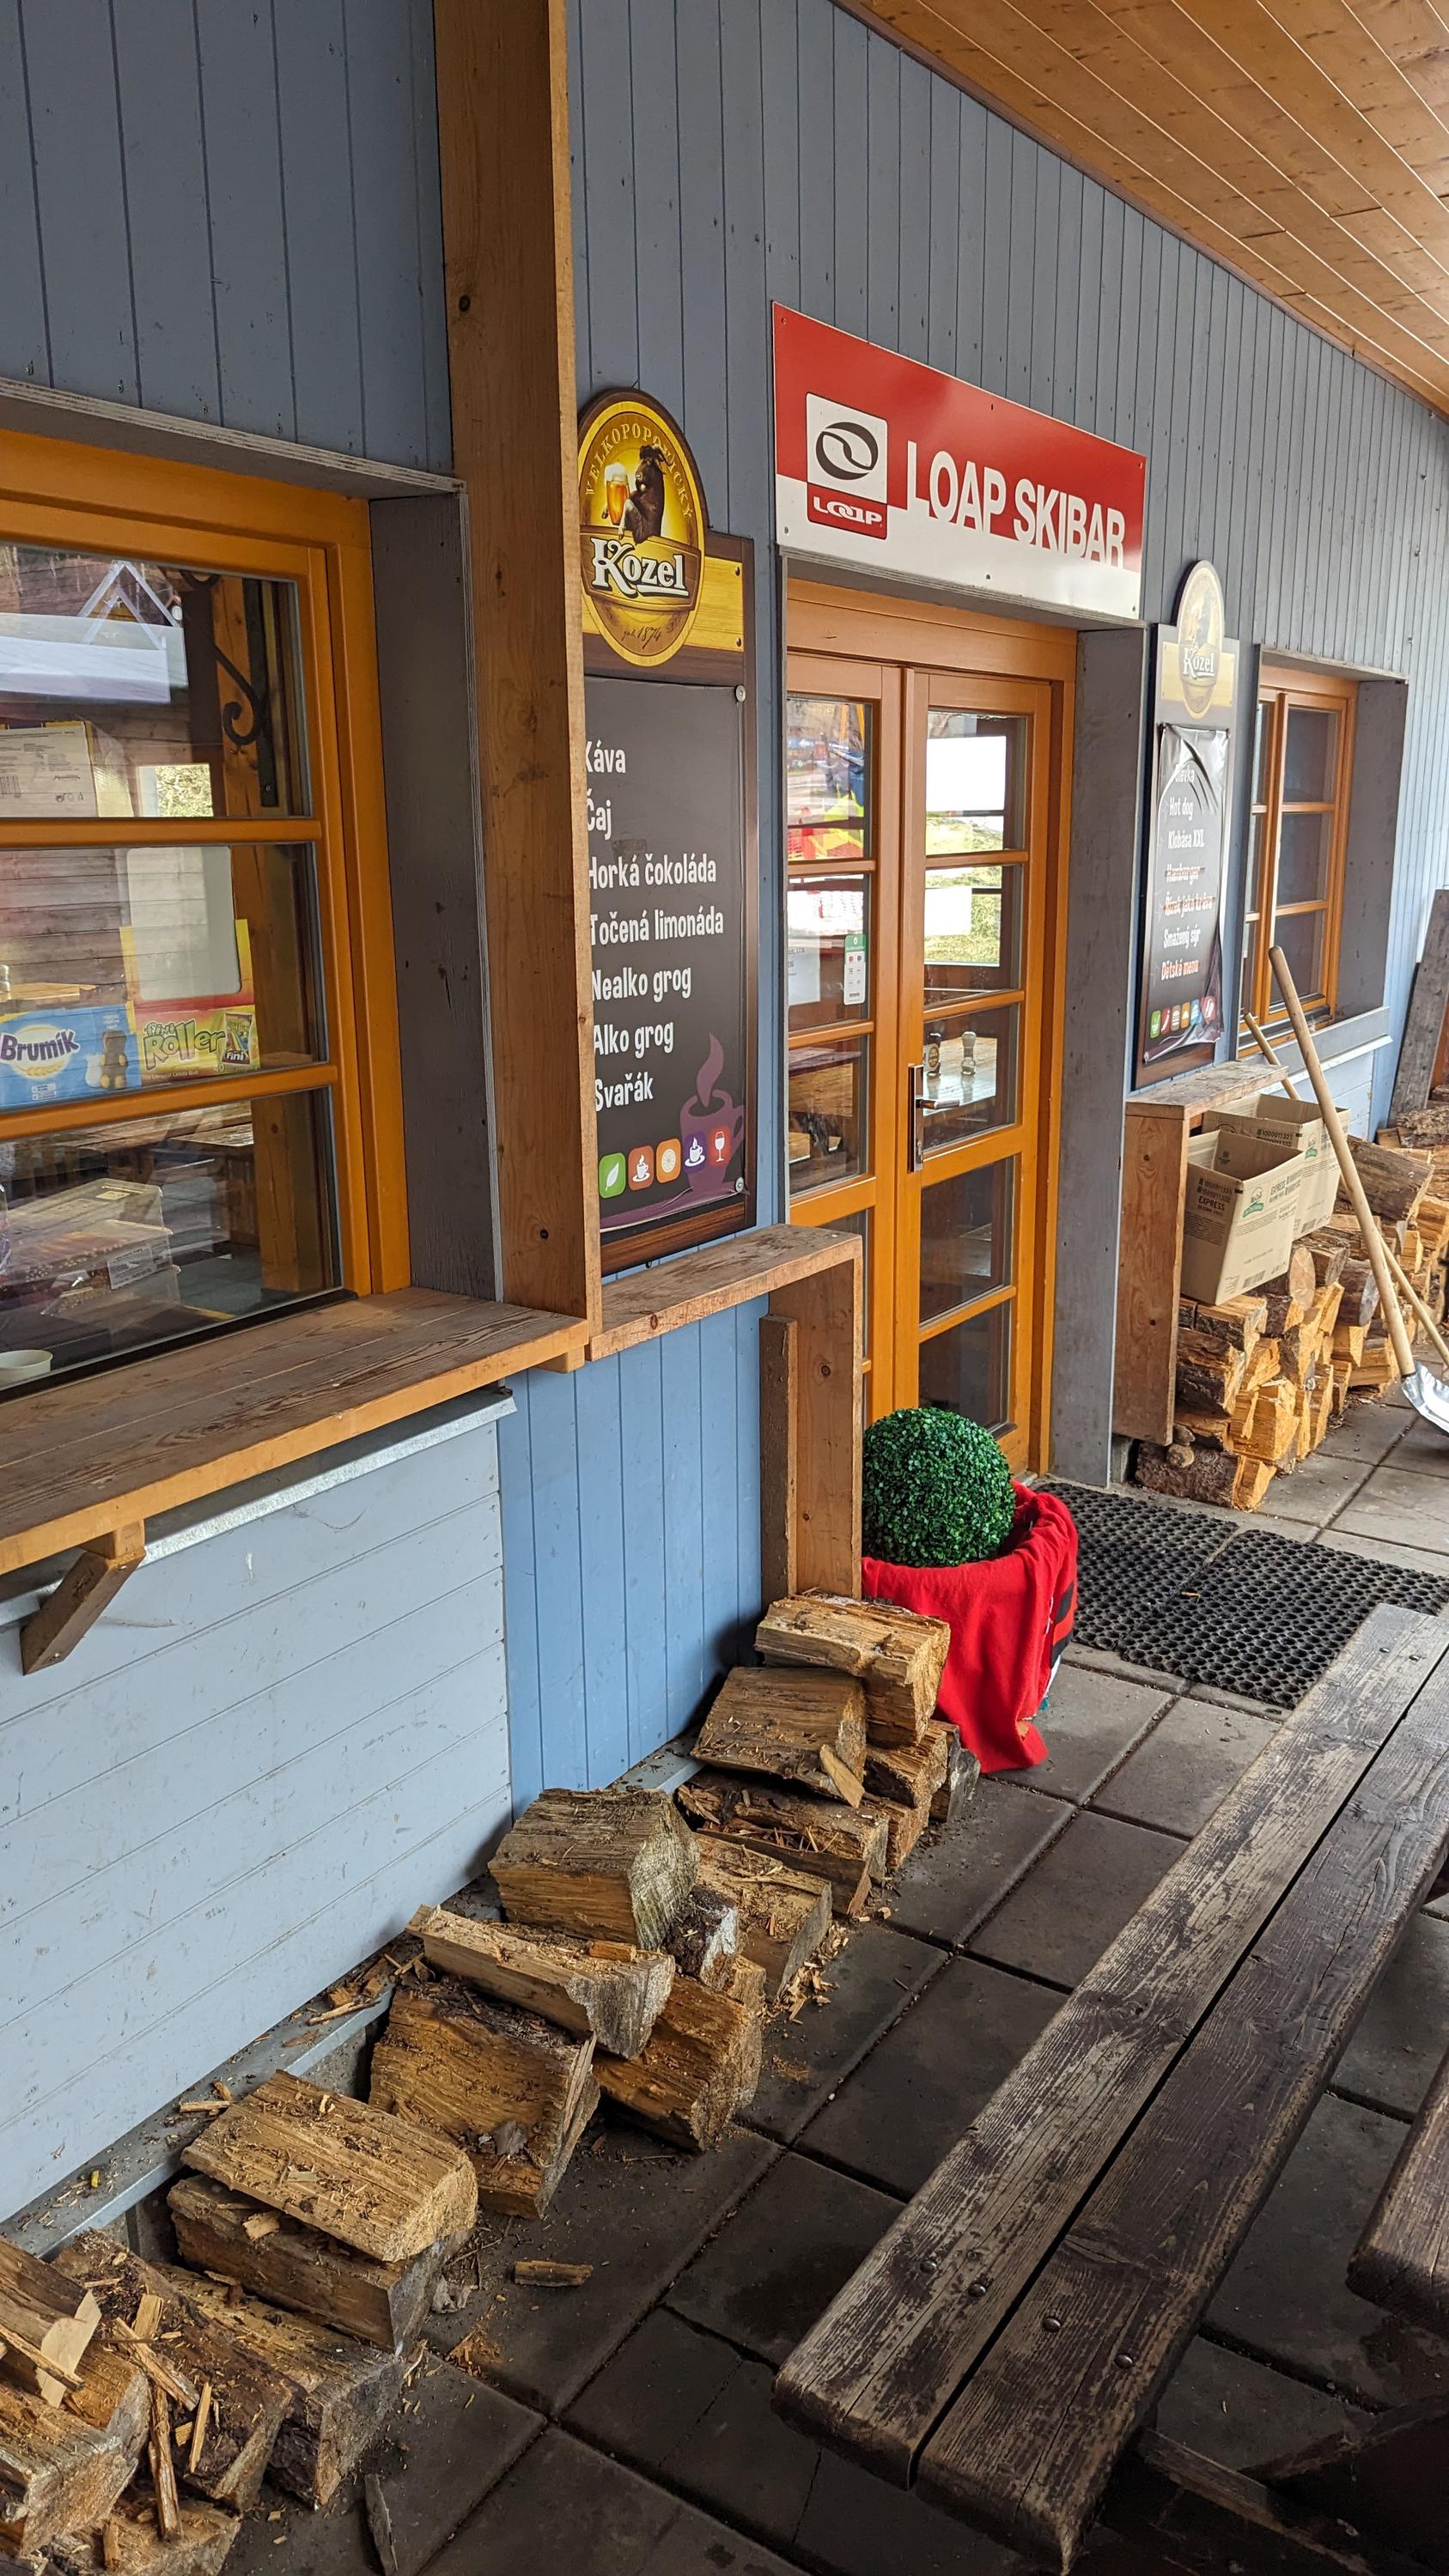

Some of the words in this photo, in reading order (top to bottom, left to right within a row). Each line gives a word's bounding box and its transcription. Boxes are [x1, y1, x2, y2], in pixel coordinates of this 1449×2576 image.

[907, 440, 1007, 534] LOAP
[1014, 478, 1125, 570] SKIBAR
[590, 537, 689, 597] Kozel
[1182, 647, 1215, 679] Kozel
[1169, 797, 1181, 817] Hot
[1182, 797, 1194, 821] dog
[1168, 829, 1192, 849] Klobása
[1193, 829, 1205, 848] XXL
[588, 854, 640, 890] Horká
[645, 853, 716, 885] čokoláda
[590, 909, 649, 946] Točená
[654, 905, 724, 940] limonáda
[1164, 925, 1190, 949] Smažený
[1190, 923, 1202, 948] sýr
[592, 967, 648, 1002] Nealko
[653, 967, 691, 1003] grog
[1161, 957, 1183, 981] Dětské
[1183, 959, 1199, 976] menu
[0, 1030, 80, 1062] Brumík
[143, 1018, 226, 1072] Roller
[594, 1024, 630, 1056] Alko
[634, 1022, 673, 1059] grog
[594, 1071, 654, 1112] Svařák
